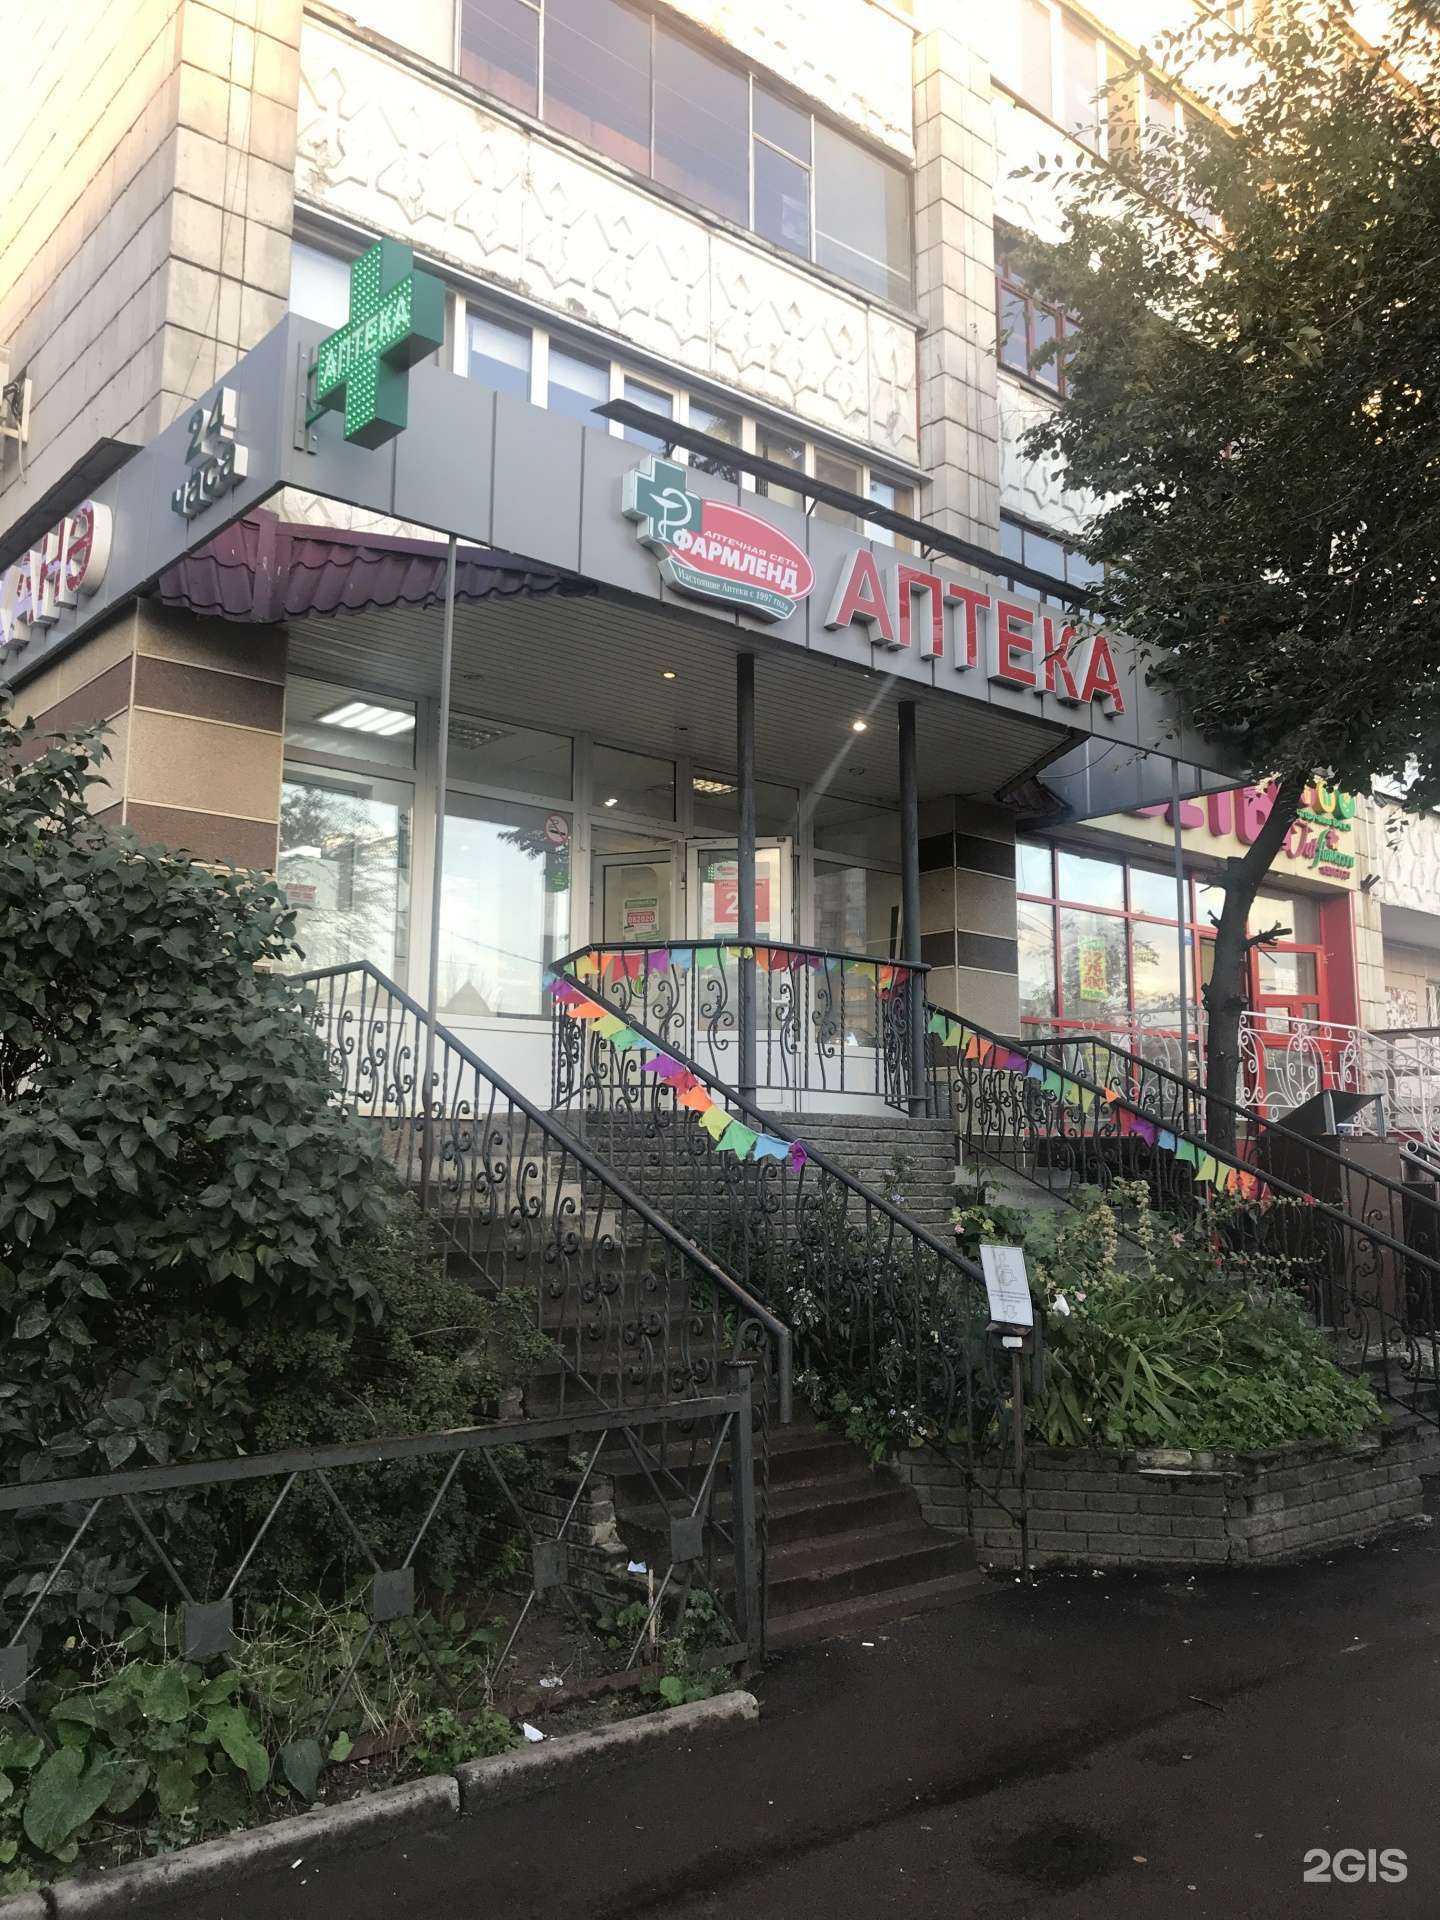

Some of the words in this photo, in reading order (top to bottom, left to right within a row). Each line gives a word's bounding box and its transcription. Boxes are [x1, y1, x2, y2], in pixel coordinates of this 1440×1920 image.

[321, 294, 411, 386] АПТЕКА
[185, 386, 237, 465] 24
[171, 441, 248, 520] часа
[672, 528, 798, 594] ФАРМЛЕНД
[703, 529, 768, 558] АПТЕЧНАЯ
[769, 552, 798, 569] СЕТЬ
[828, 548, 1126, 716] АПТЕКА
